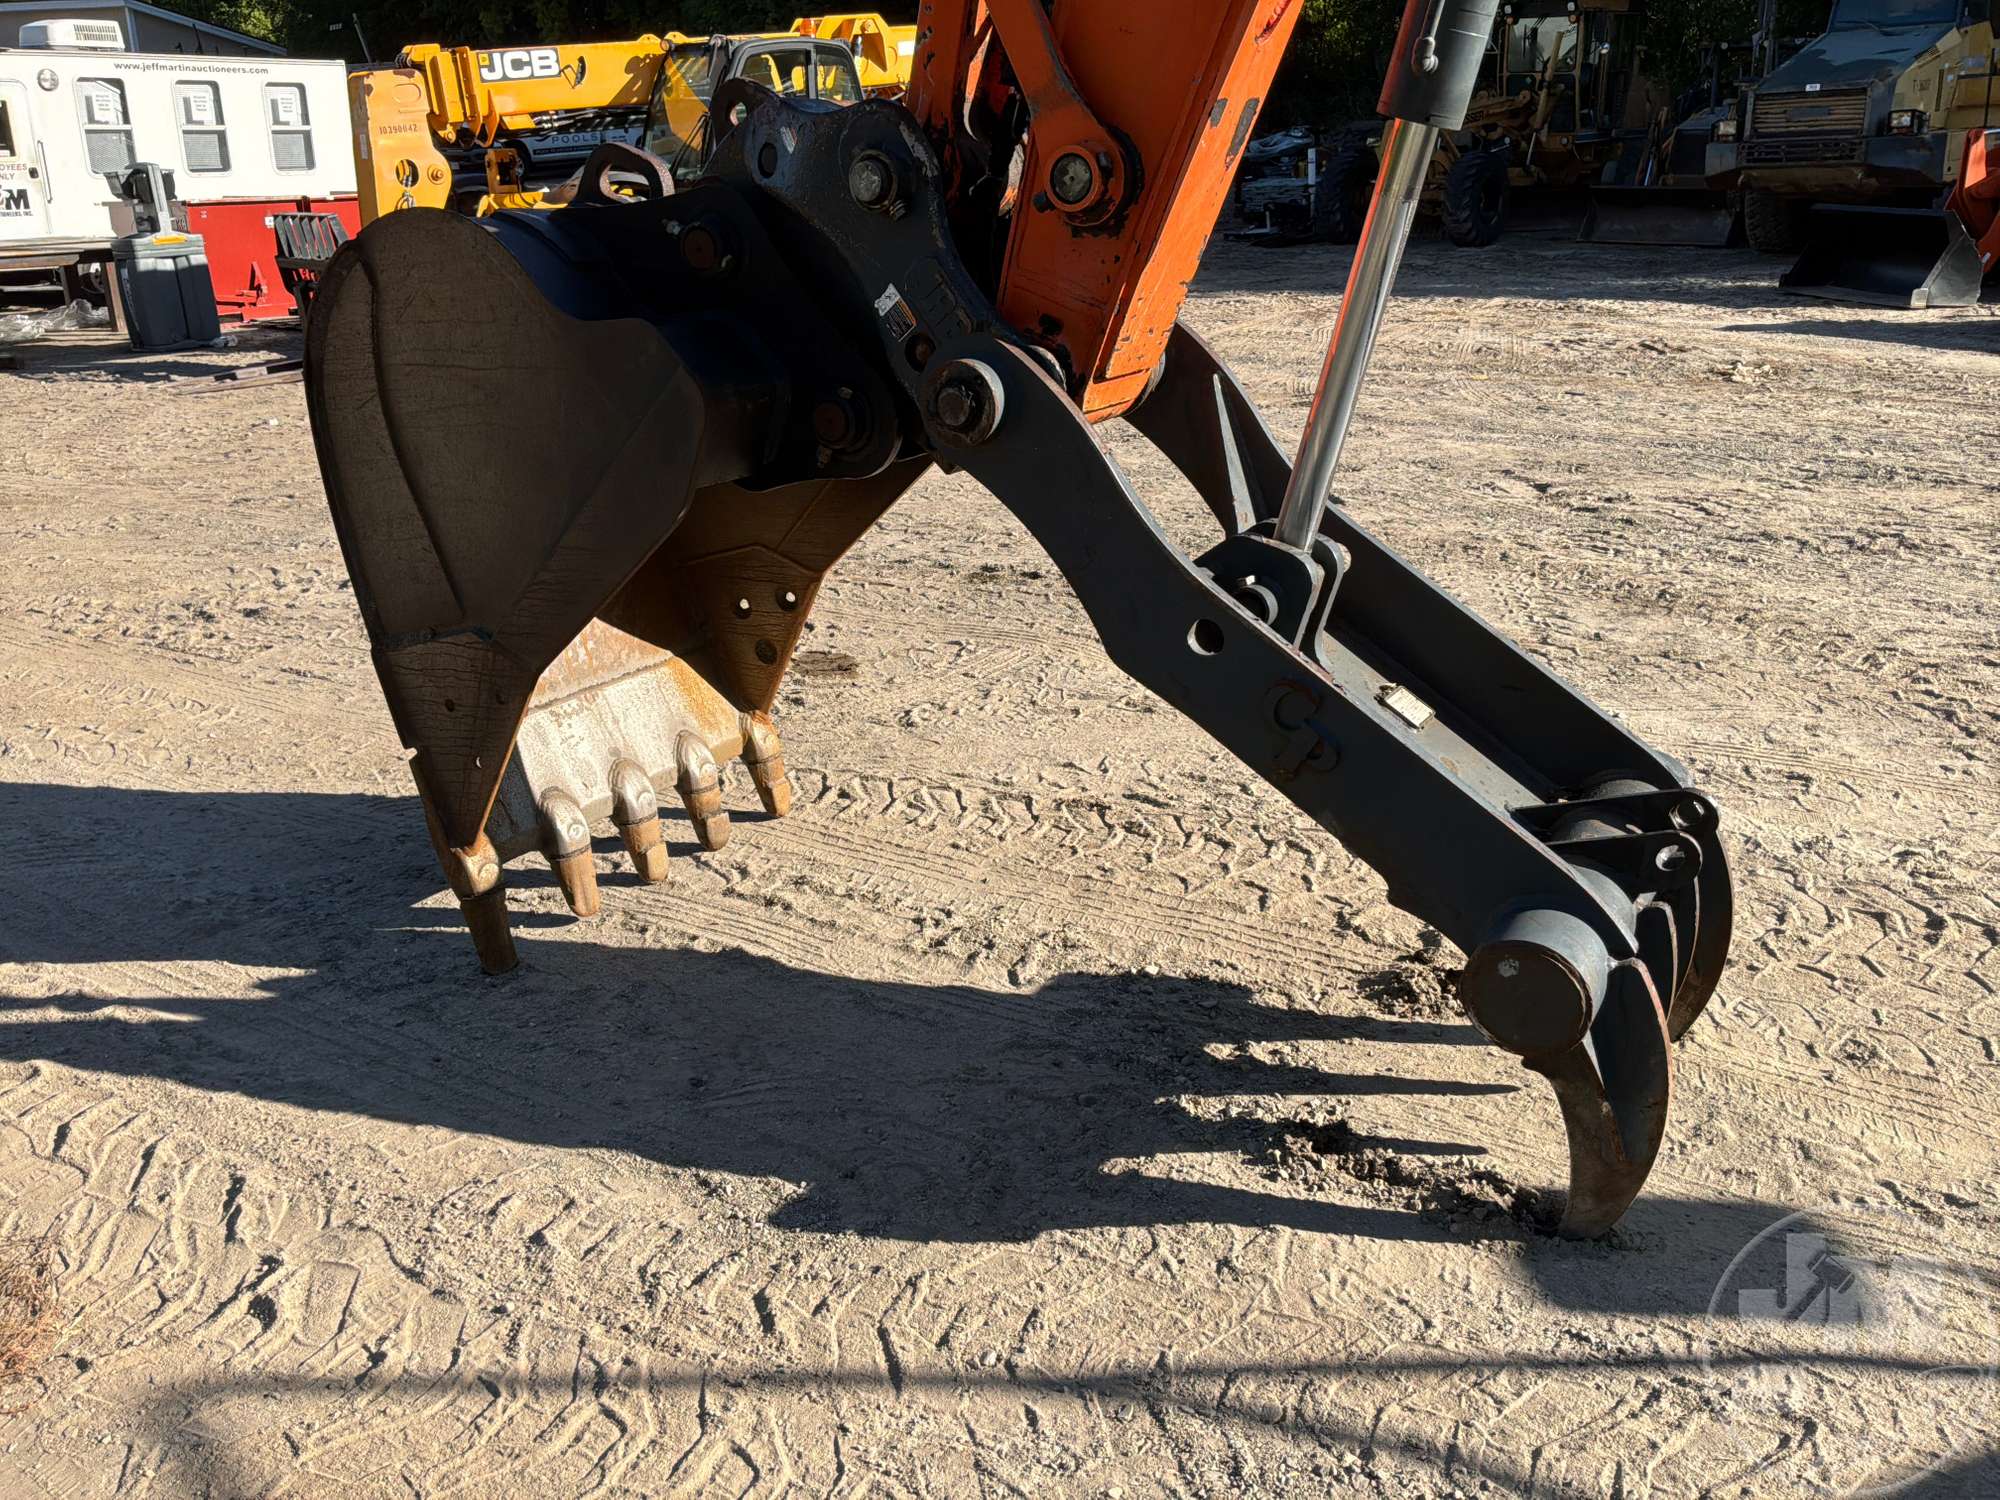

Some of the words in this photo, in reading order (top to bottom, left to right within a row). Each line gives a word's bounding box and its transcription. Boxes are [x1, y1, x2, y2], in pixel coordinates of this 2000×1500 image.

[113, 61, 269, 75] www.jeffmartinauctioneers.com
[480, 49, 560, 81] JCB
[0, 186, 30, 210] M
